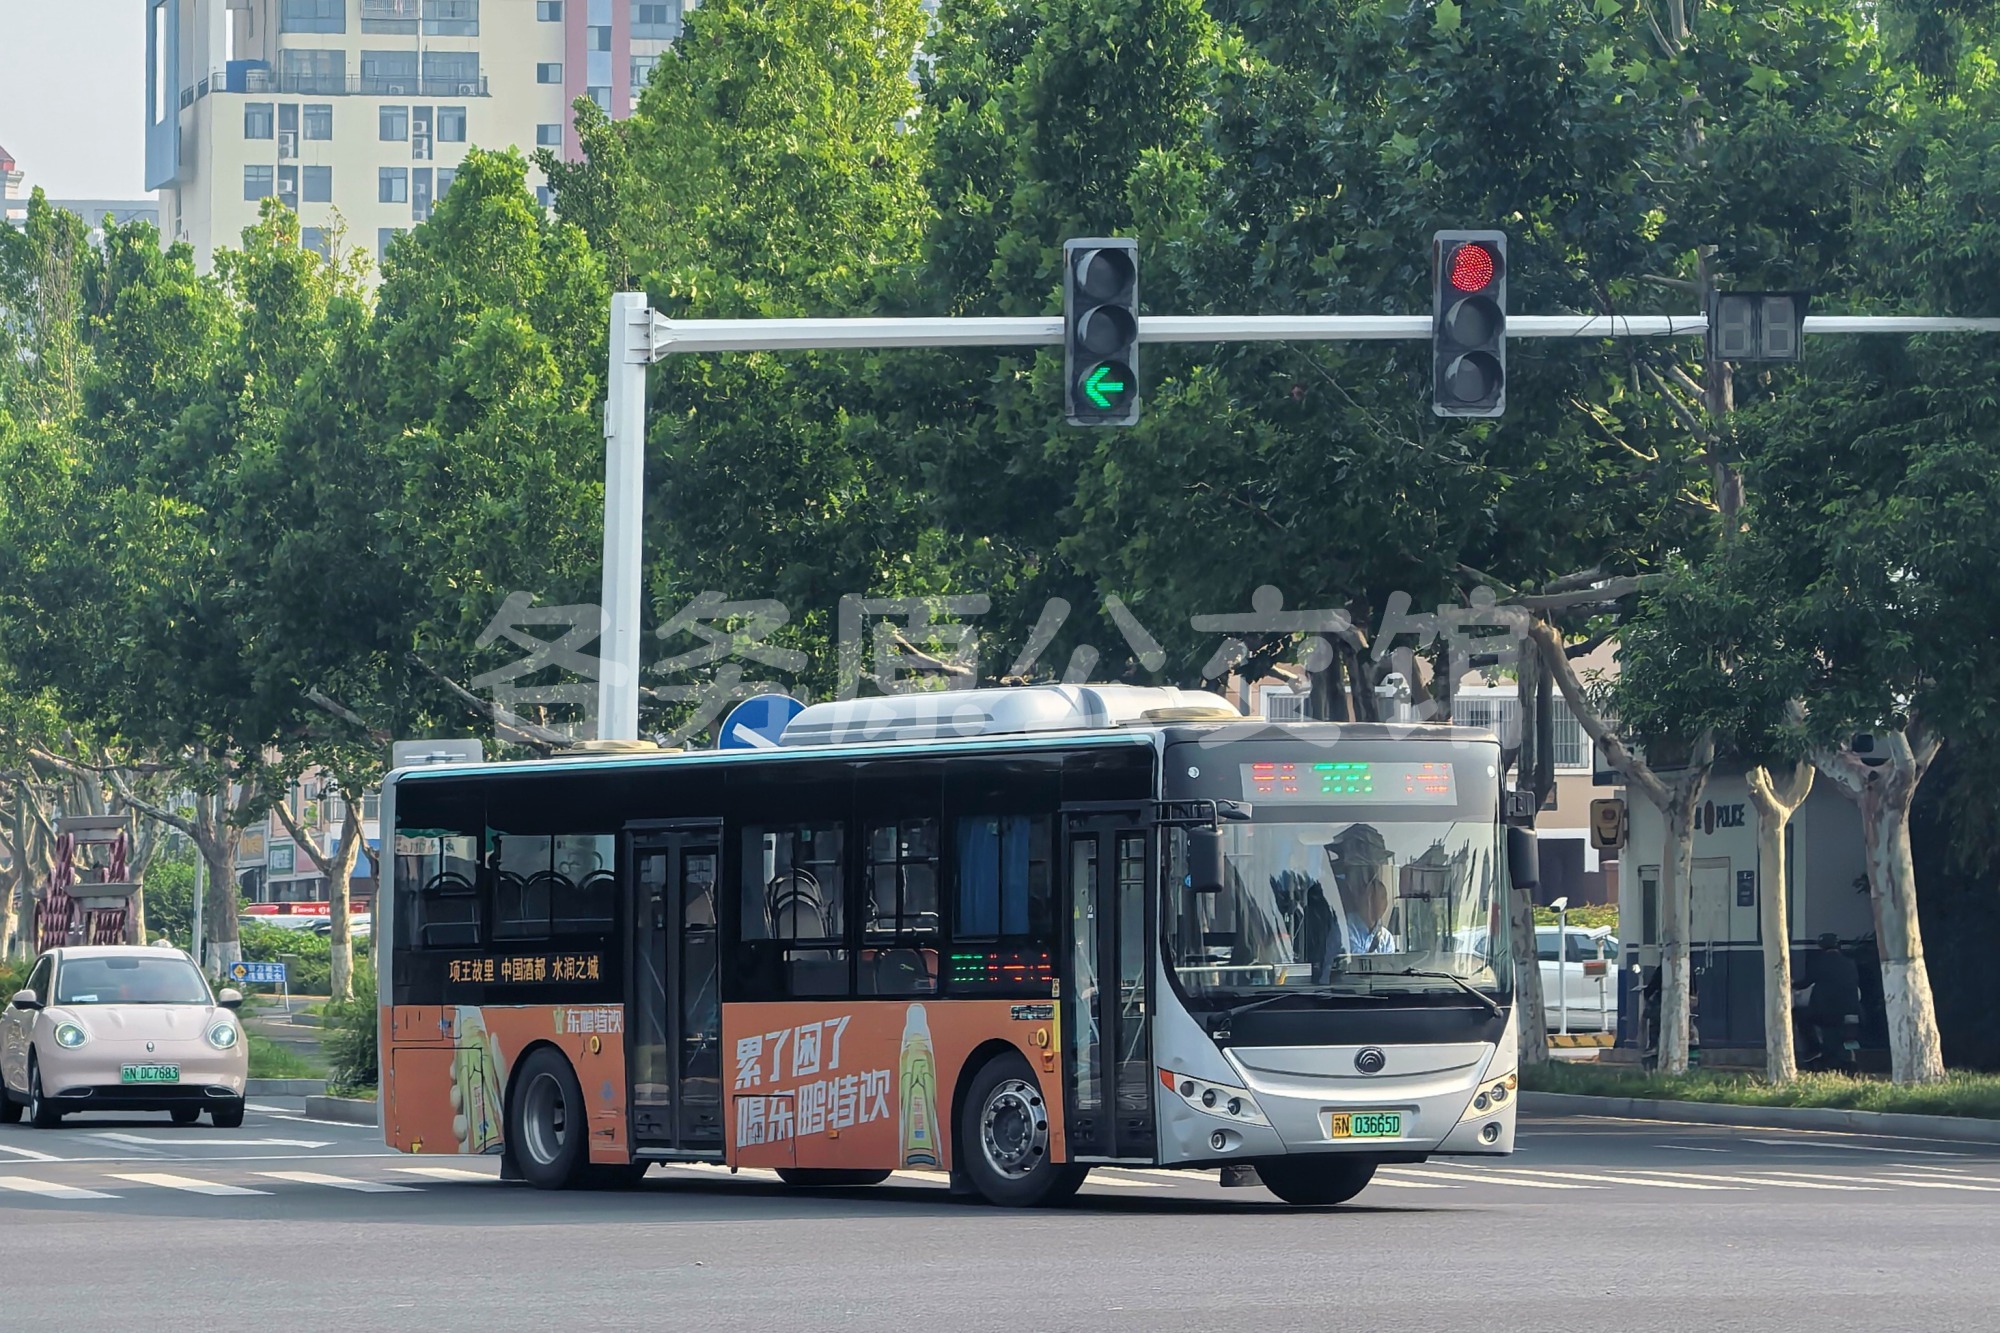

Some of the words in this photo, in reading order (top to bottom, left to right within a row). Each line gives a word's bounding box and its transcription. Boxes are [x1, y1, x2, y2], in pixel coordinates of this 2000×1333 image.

[1716, 803, 1745, 828] POLICE
[449, 959, 495, 983] 项王故里
[501, 956, 547, 983] 中国酒都
[552, 954, 600, 981] 水润之城
[566, 1008, 623, 1033] 东鹏特饮
[734, 1015, 852, 1090] 累了困了
[736, 1069, 891, 1148] 喝东鹏特饮
